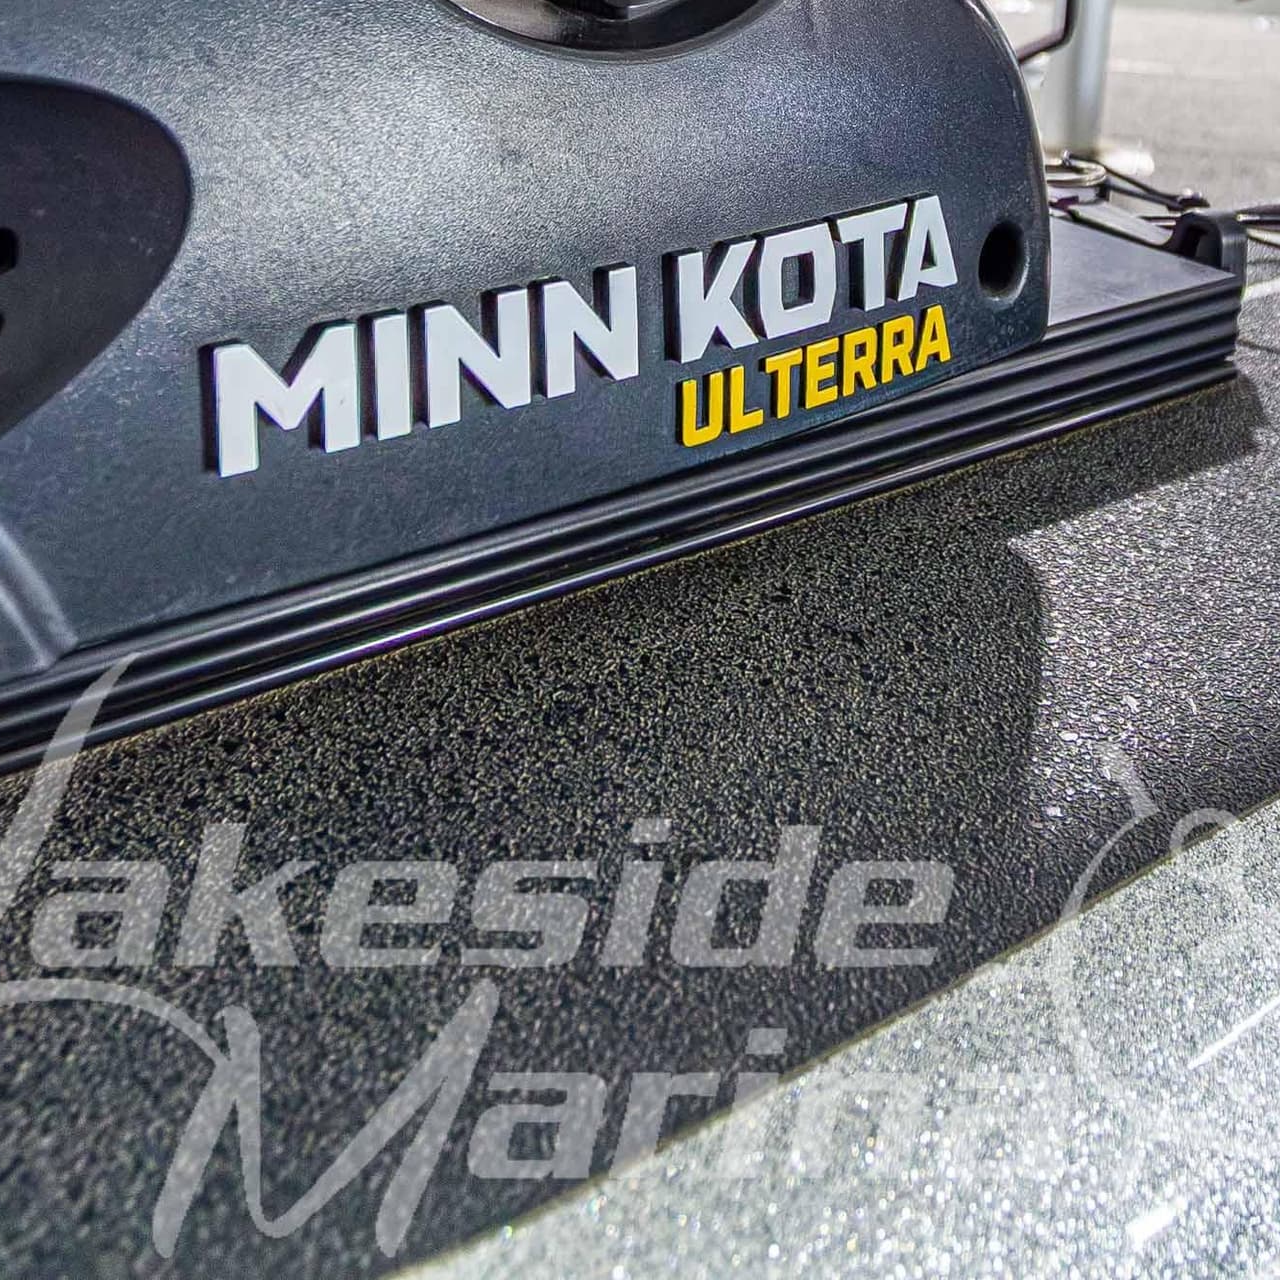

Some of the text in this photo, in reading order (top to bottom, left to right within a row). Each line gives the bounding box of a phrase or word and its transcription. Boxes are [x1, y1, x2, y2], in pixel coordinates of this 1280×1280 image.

[202, 194, 959, 478] MINN KOTA
[675, 304, 952, 448] ULTERRA
